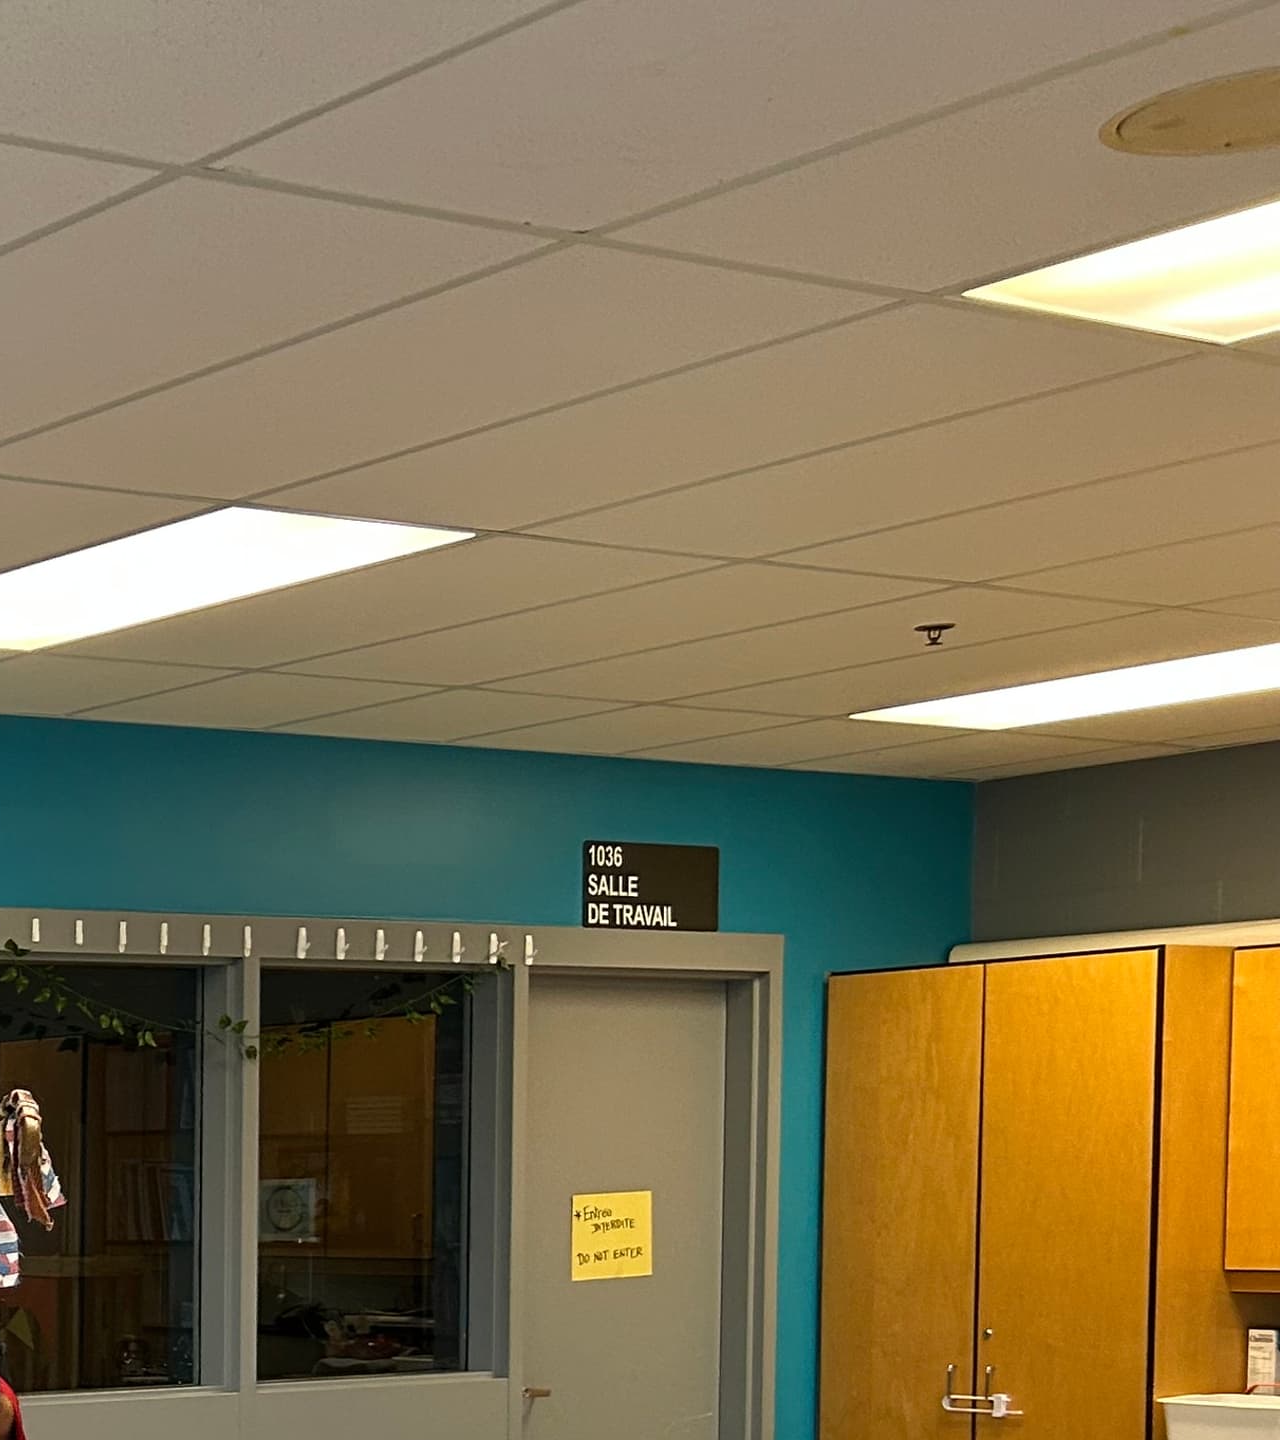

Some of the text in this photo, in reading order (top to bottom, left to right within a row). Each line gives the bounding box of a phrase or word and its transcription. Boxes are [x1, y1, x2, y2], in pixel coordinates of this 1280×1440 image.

[588, 844, 623, 868] 1036
[587, 873, 639, 897] SALLE
[587, 902, 678, 928] DE TRAVAIL
[576, 1246, 643, 1266] DO NOT ENTER
